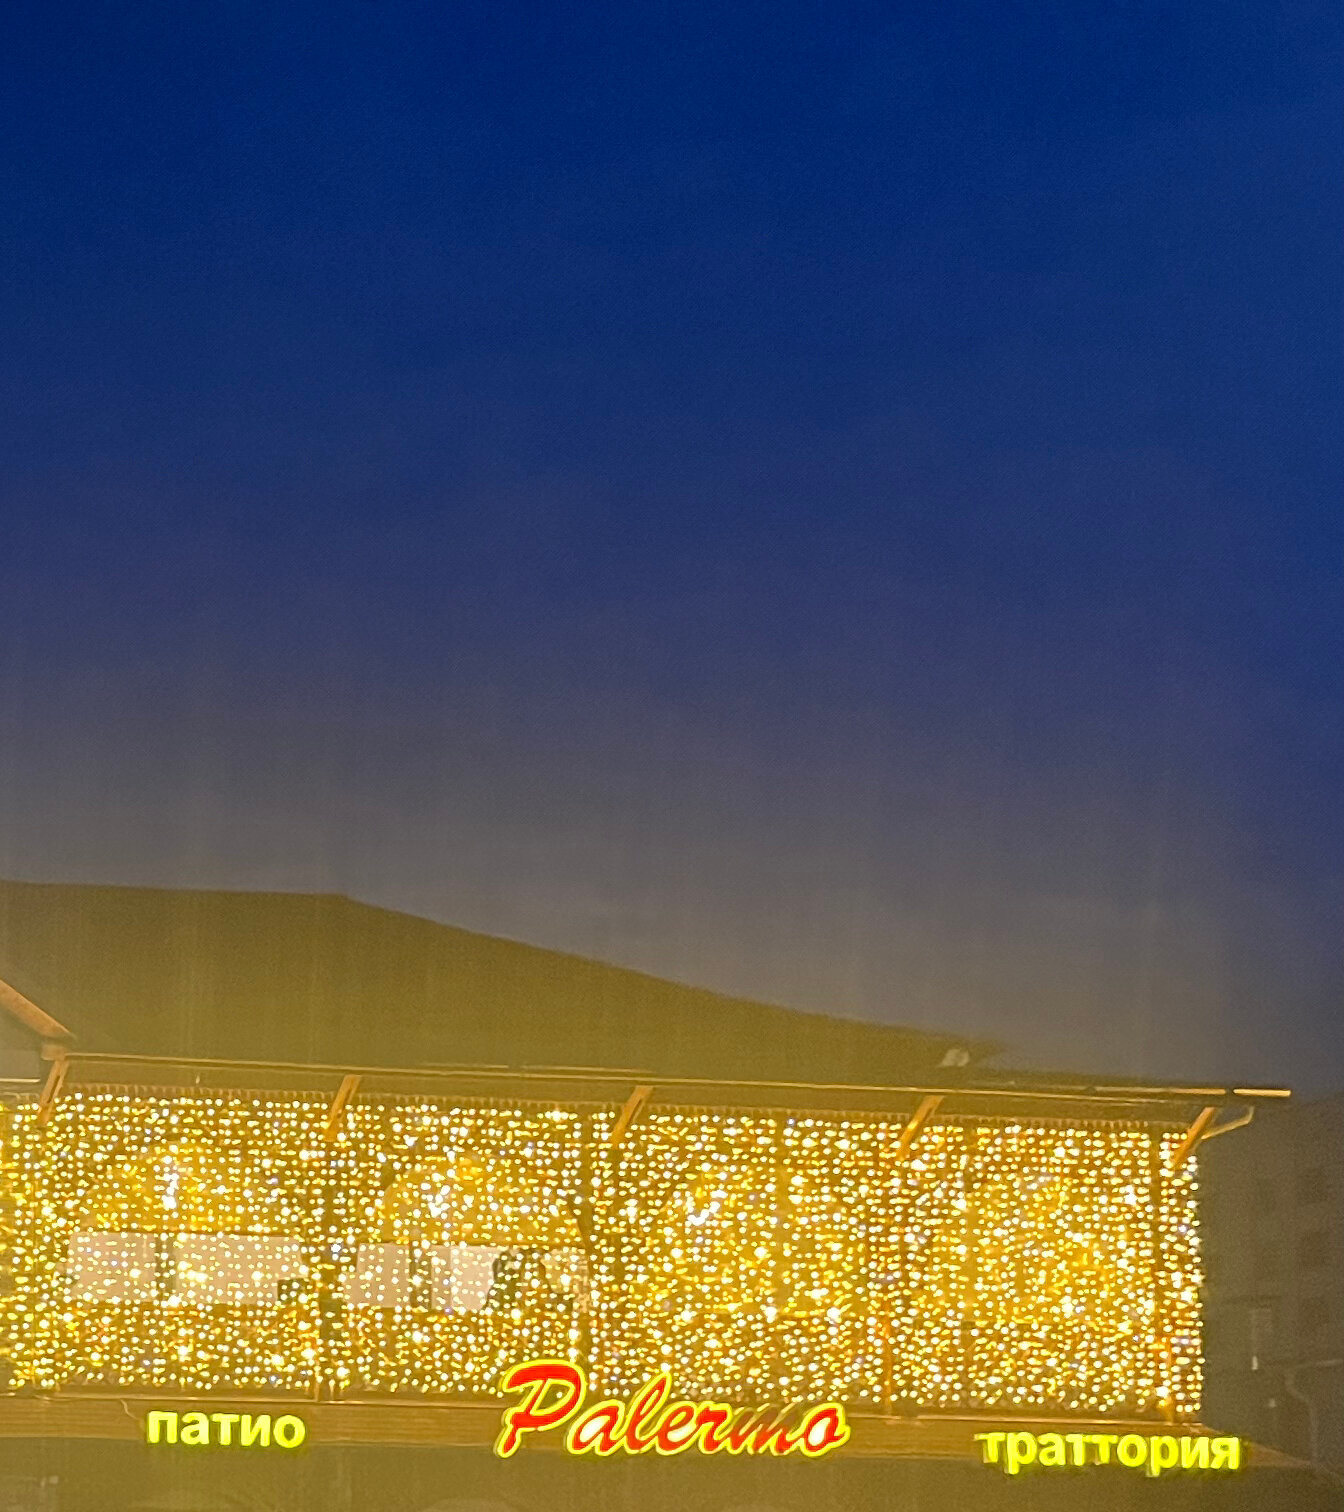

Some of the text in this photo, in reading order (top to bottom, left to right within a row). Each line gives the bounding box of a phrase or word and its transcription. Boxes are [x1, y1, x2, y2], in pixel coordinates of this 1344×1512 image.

[147, 1409, 306, 1449] патио
[495, 1359, 851, 1459] Palermo
[974, 1431, 1242, 1477] траттория
